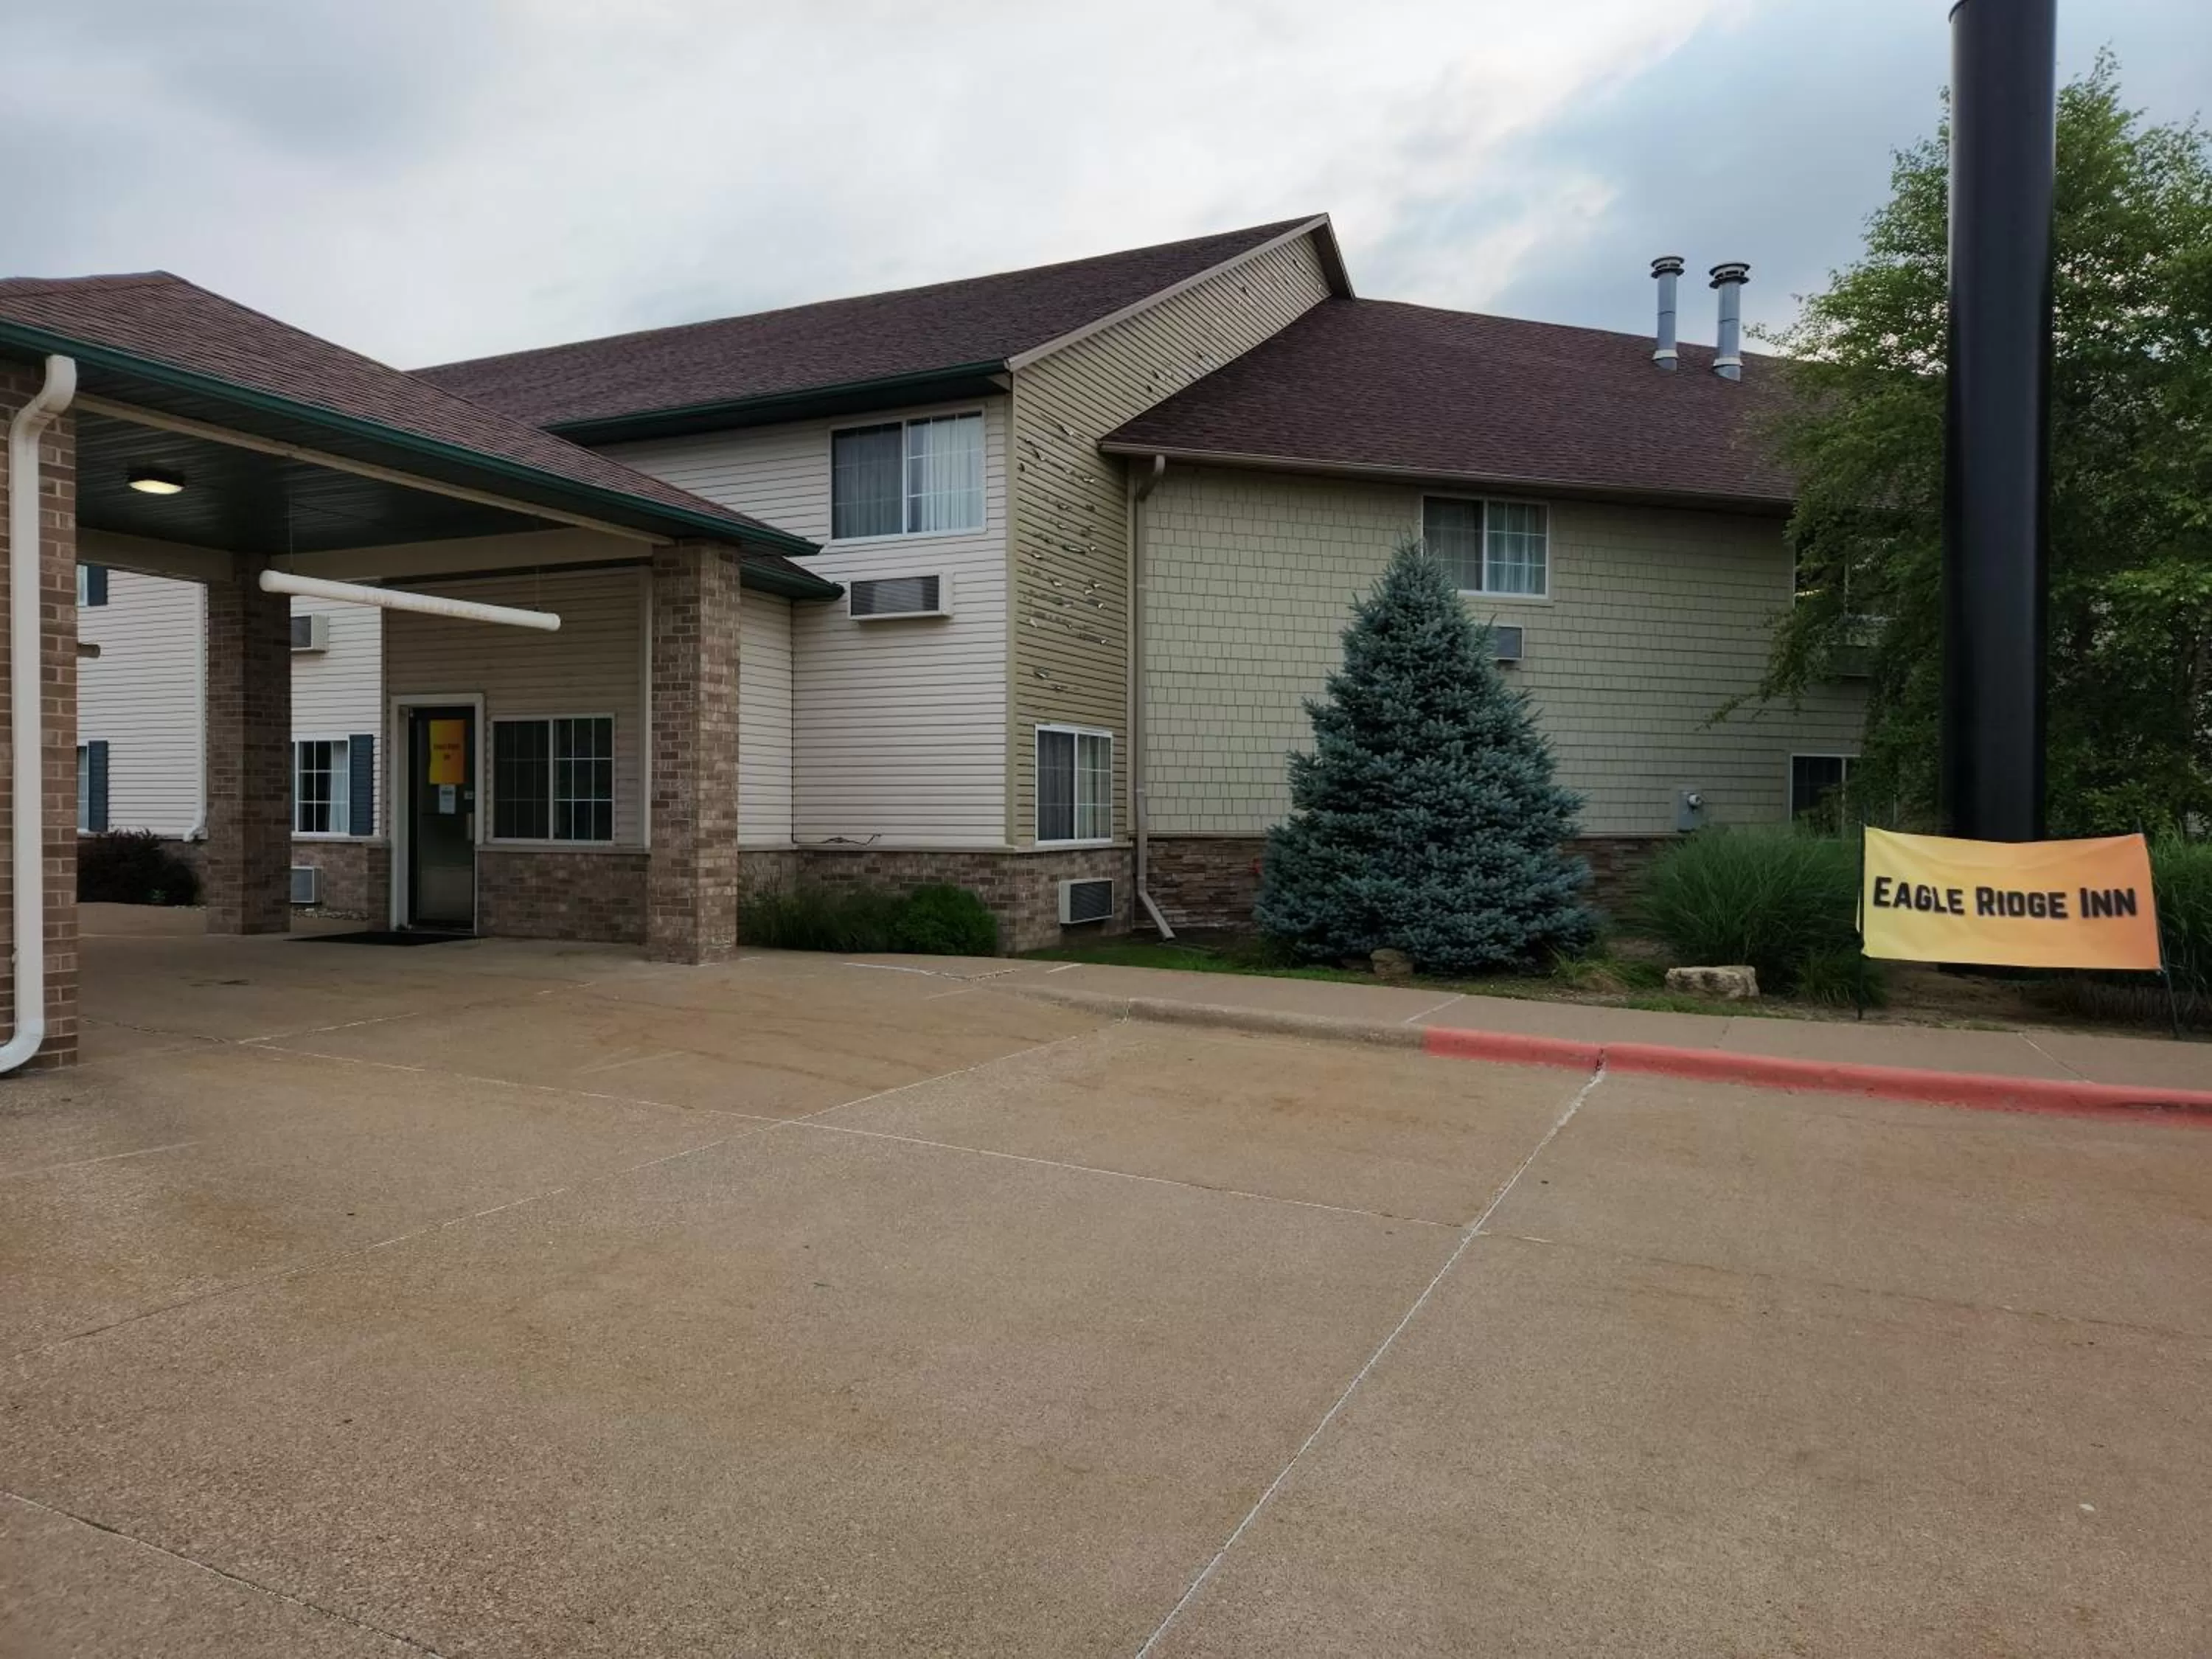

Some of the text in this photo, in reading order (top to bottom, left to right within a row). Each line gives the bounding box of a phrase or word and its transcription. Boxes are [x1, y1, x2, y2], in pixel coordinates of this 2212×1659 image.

[1873, 877, 2137, 919] EAGLE RIDGE INN
